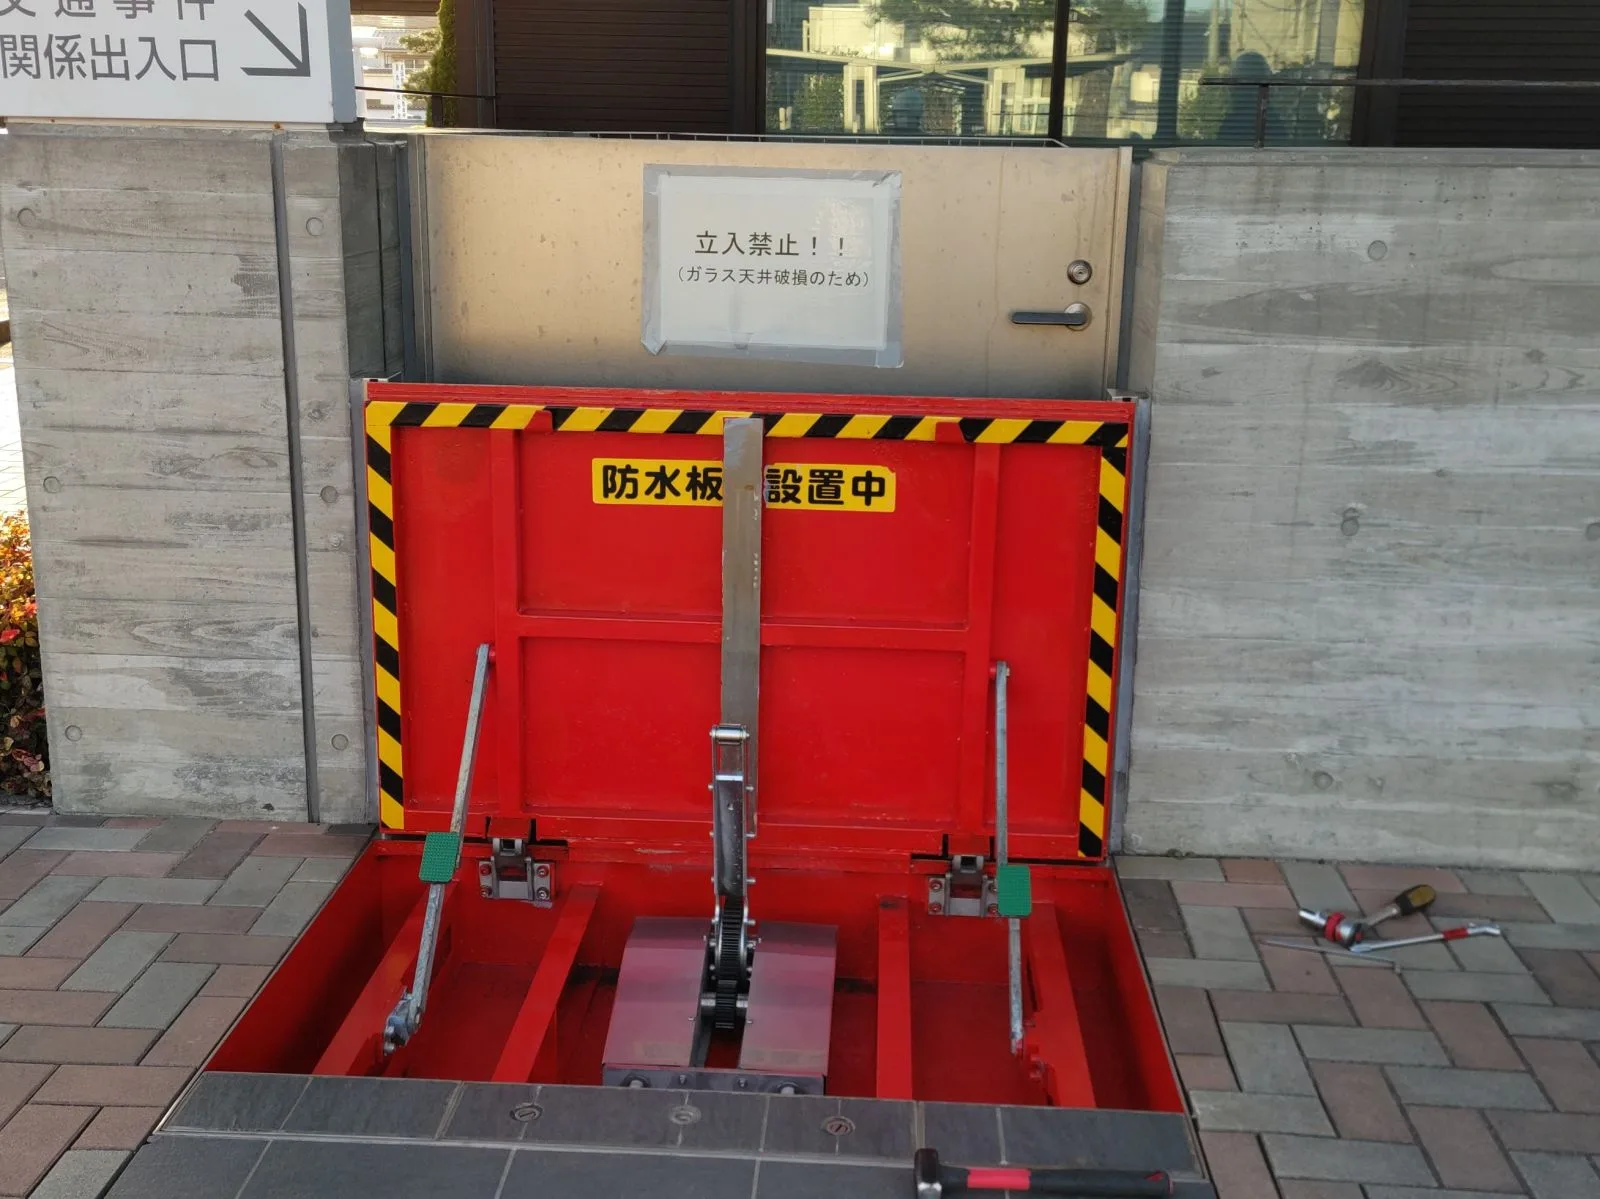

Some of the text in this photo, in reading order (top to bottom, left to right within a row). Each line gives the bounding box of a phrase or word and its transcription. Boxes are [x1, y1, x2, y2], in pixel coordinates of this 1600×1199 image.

[0, 33, 219, 81] 関係出入口
[694, 230, 844, 257] 立入禁止！！
[677, 265, 870, 288] （ガラス天井破損のため）
